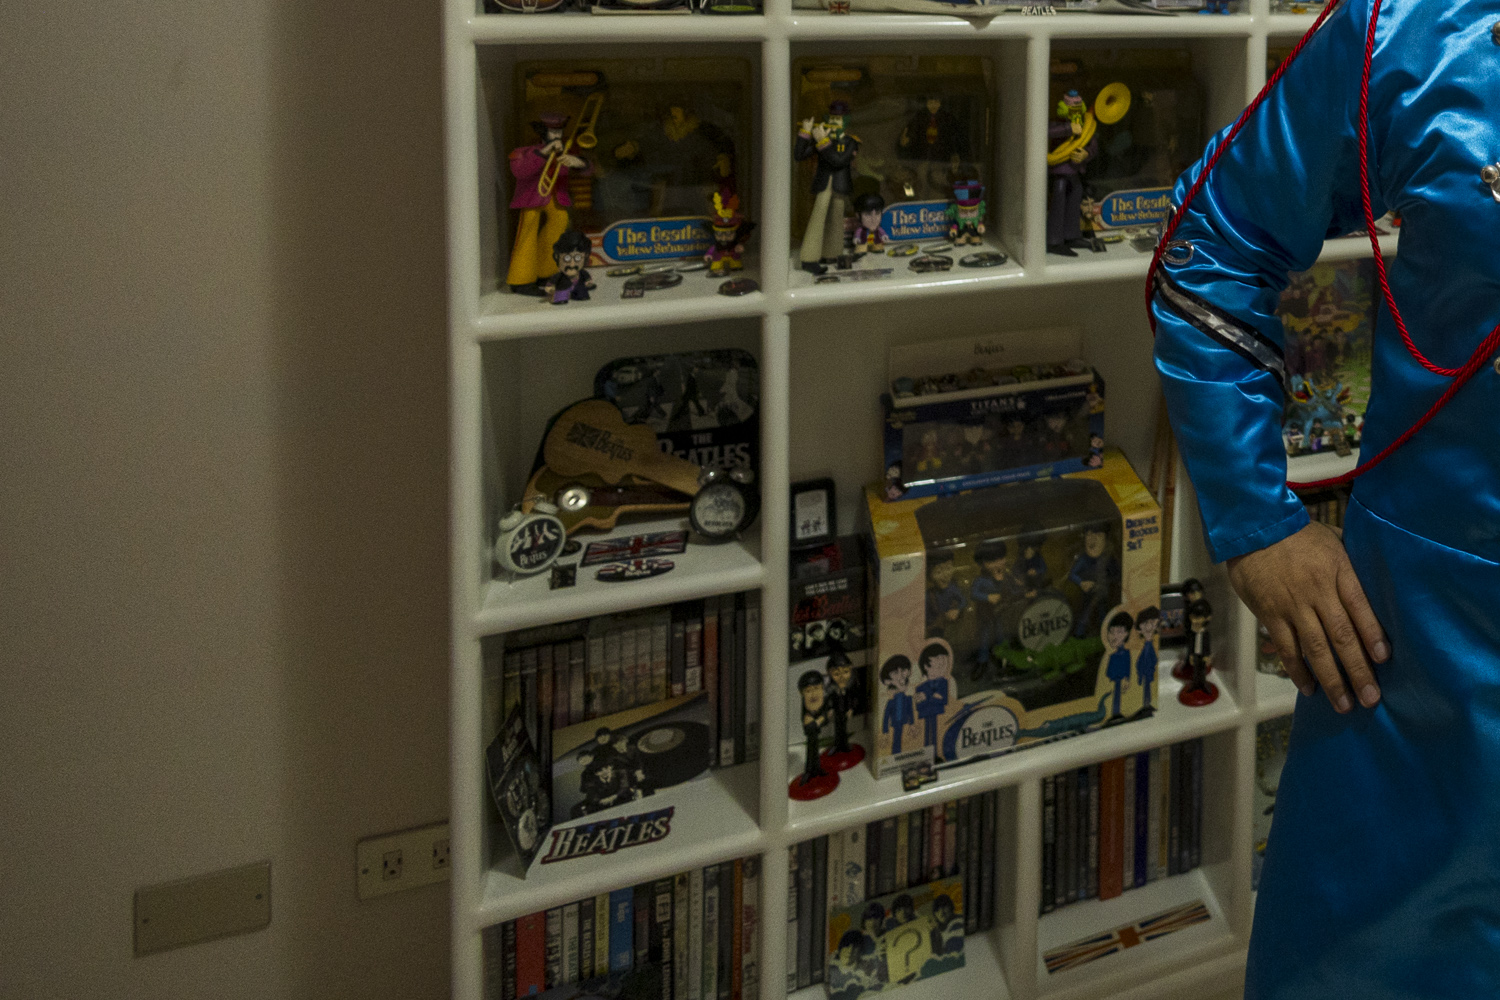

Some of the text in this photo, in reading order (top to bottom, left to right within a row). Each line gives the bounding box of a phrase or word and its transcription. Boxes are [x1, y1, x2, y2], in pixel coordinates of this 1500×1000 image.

[1021, 5, 1057, 16] BEATLES
[1110, 198, 1134, 213] The
[890, 209, 917, 226] The
[615, 224, 711, 245] The Beatles
[691, 433, 714, 446] THE
[1022, 617, 1069, 639] BEATLES
[961, 724, 1013, 749] BEATLES
[549, 816, 670, 860] BEATLES
[567, 952, 578, 982] BEATLE
